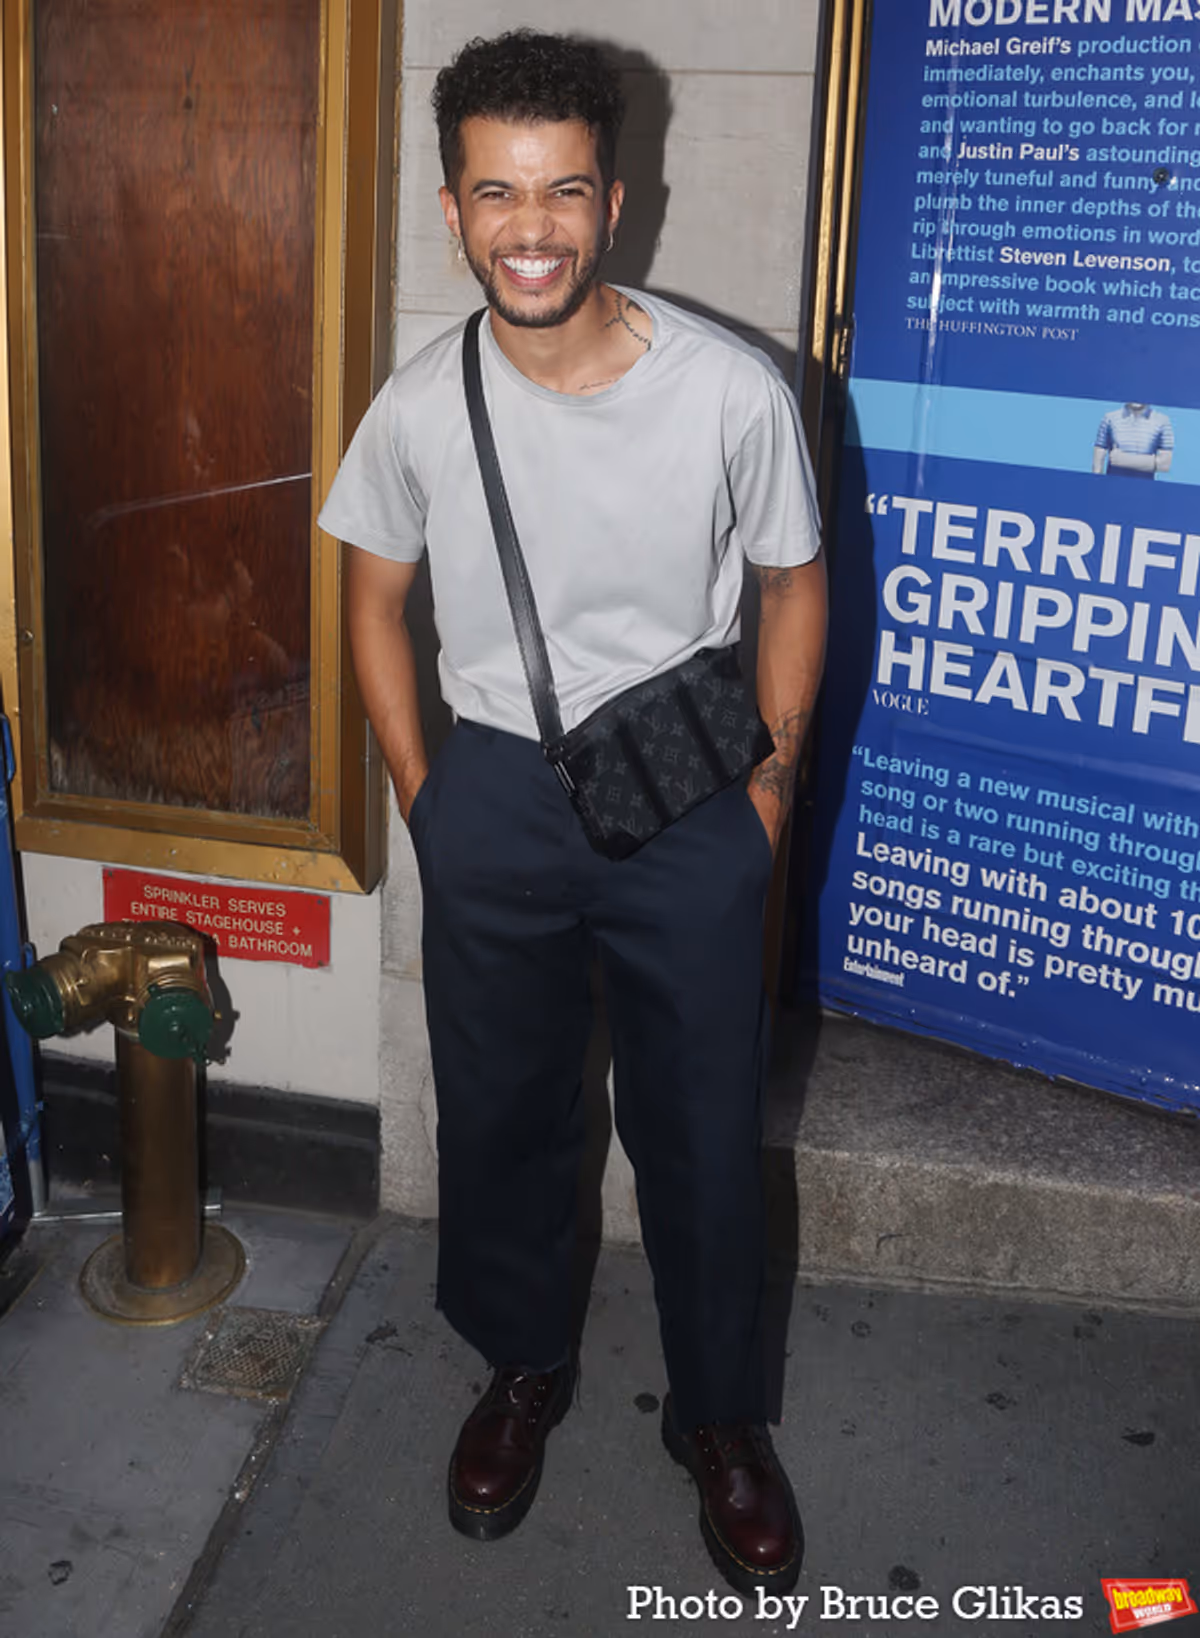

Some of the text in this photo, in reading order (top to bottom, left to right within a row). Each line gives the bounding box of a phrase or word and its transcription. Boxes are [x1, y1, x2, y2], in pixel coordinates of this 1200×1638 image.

[929, 0, 1200, 27] MODERN MA
[925, 36, 1192, 57] Michael Greif’s production
[924, 65, 1195, 84] immediately, enchants you,
[921, 91, 1016, 108] emotional
[1023, 91, 1137, 111] turbulence,
[1144, 90, 1183, 109] and
[920, 117, 952, 134] and
[960, 117, 1035, 137] wanting
[1043, 118, 1061, 134] to
[1069, 120, 1095, 138] go
[1102, 116, 1151, 135] back
[1158, 116, 1189, 135] for
[918, 141, 1200, 168] and Justin Paul’s astounding
[916, 168, 979, 188] merely
[985, 169, 1053, 188] tuneful
[1060, 171, 1097, 189] and
[914, 194, 1200, 219] plumb the inner depths of th
[913, 218, 936, 238] rip
[942, 219, 1016, 241] through
[1022, 222, 1116, 242] emotions
[1123, 225, 1141, 243] in
[911, 243, 994, 262] Librettist
[999, 246, 1066, 266] Steven
[1074, 250, 1176, 276] Levenson,
[909, 271, 930, 284] an
[1046, 274, 1096, 294] book
[1103, 280, 1162, 299] which
[979, 298, 1020, 315] with
[1026, 302, 1099, 320] warmth
[1106, 307, 1144, 324] and
[939, 321, 1036, 339] HUFFINGTON
[1042, 327, 1079, 341] POST
[873, 689, 929, 716] VOGUE
[852, 745, 1199, 839] “Leaving a new musical with
[861, 780, 915, 808] song
[923, 793, 948, 813] or
[954, 797, 999, 824] two
[1007, 811, 1100, 851] running
[859, 805, 913, 834] head
[921, 818, 939, 840] is
[947, 828, 961, 845] a
[969, 831, 1016, 858] rare
[1024, 842, 1064, 871] but
[1072, 856, 1171, 898] exciting
[857, 832, 970, 887] Leaving
[980, 864, 1047, 901] with
[1059, 886, 1158, 929] about
[144, 884, 286, 917] SPRINKLER SERVES
[852, 869, 942, 911] songs
[952, 895, 1071, 948] running
[131, 901, 178, 921] ENTIRE
[186, 910, 284, 935] STAGEHOUSE
[229, 935, 312, 957] BATHROOM
[848, 935, 968, 984] unheard
[849, 902, 914, 934] your
[922, 916, 998, 958] head
[1009, 939, 1035, 967] is
[1045, 954, 1143, 1001] pretty
